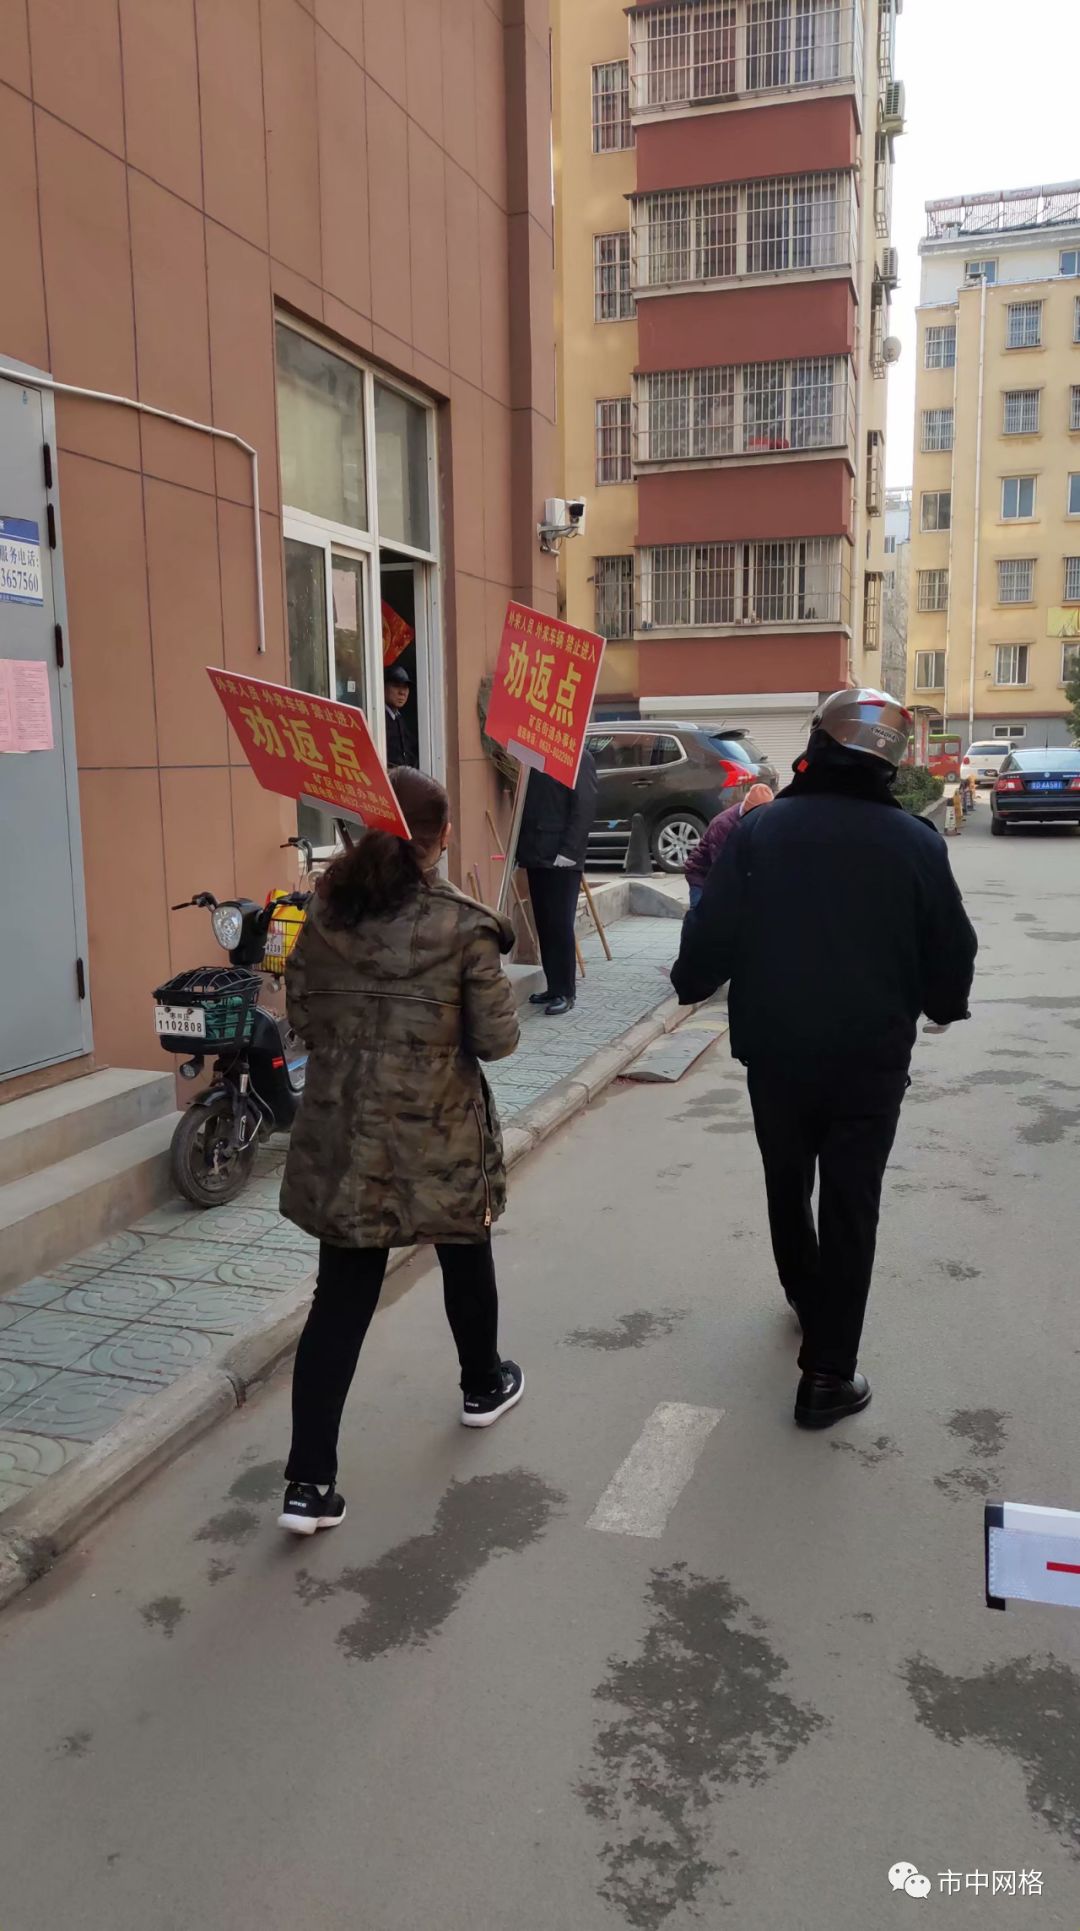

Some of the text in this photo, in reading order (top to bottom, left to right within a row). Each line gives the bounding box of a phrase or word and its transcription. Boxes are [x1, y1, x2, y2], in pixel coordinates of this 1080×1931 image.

[1, 567, 39, 592] 3657560
[509, 611, 595, 662] 外来人员 外来车辆 禁止进入
[215, 677, 360, 731] 外来人员 外来车辆 禁止进入
[504, 641, 581, 726] 劝返点
[239, 706, 371, 784] 劝返点
[159, 1019, 202, 1032] 1102808
